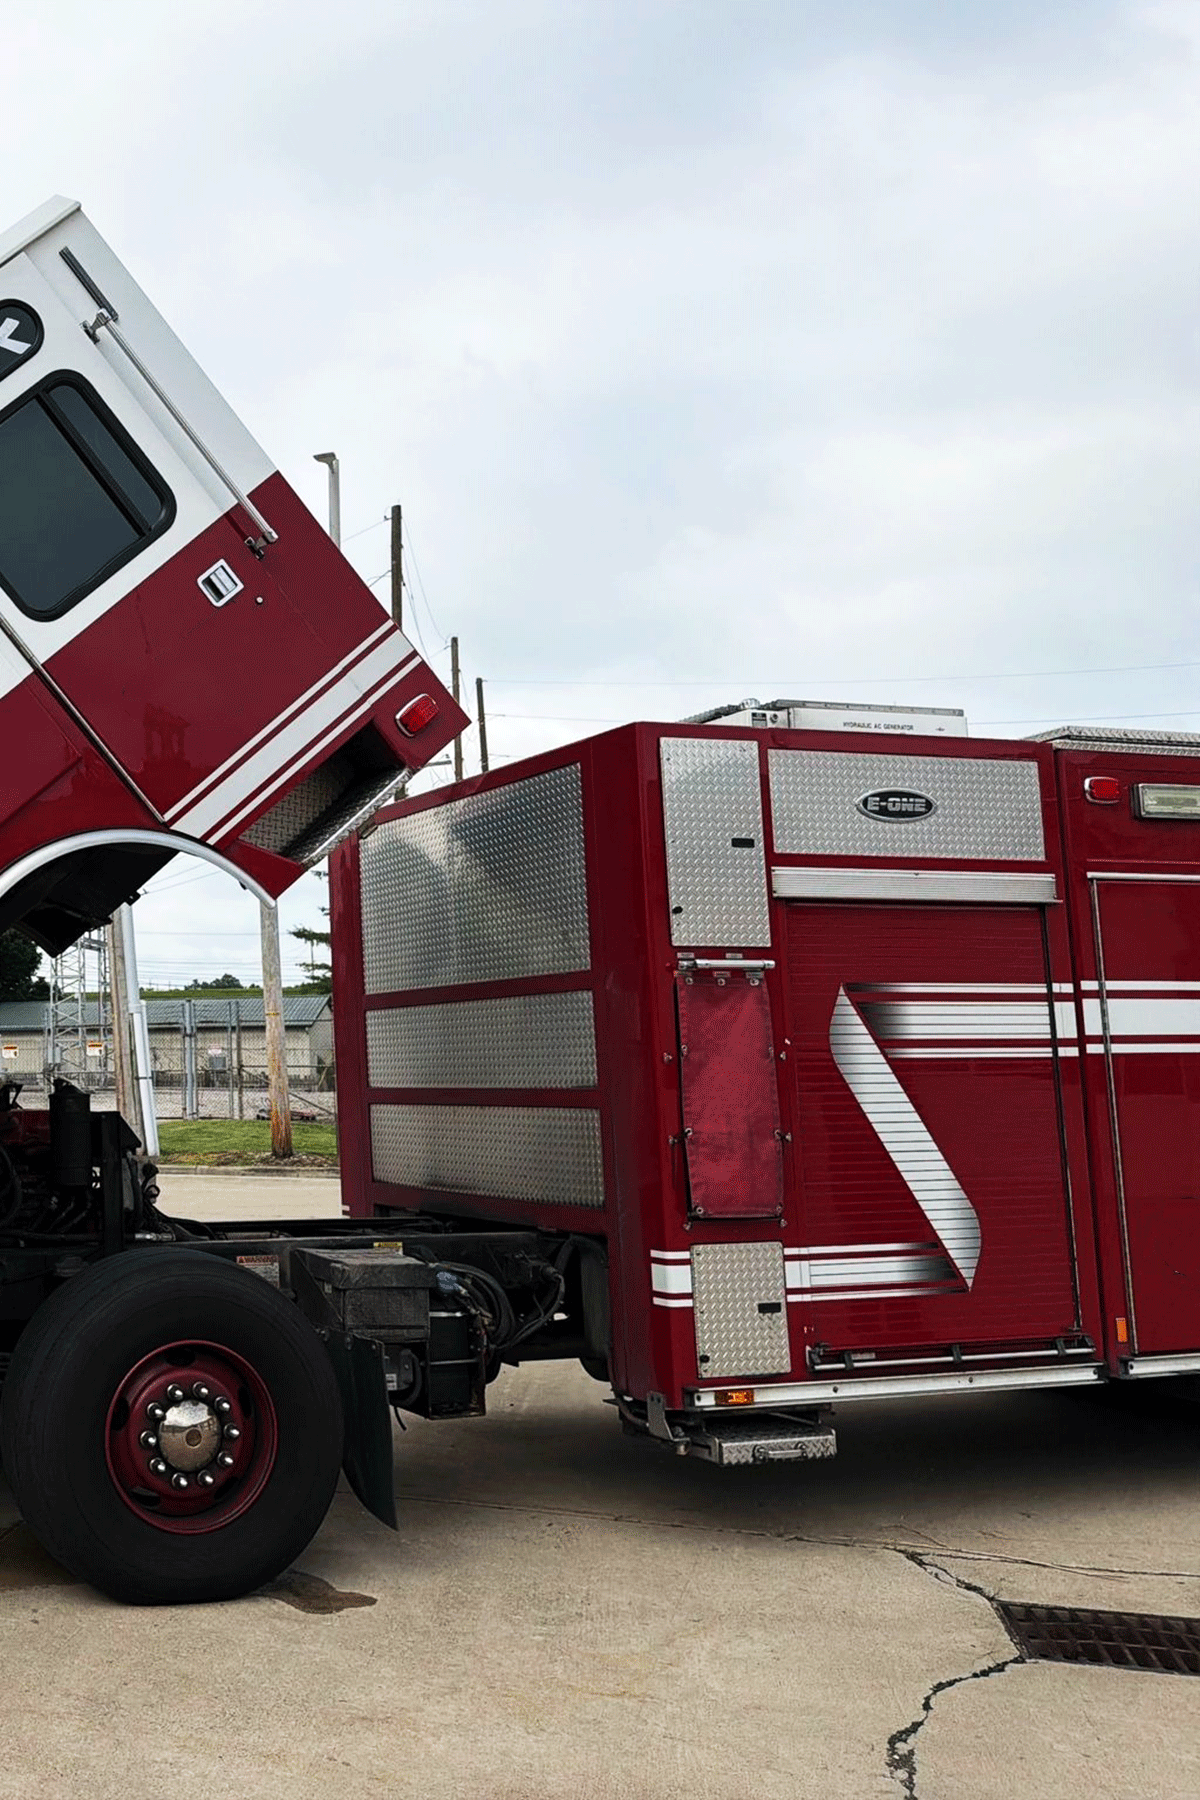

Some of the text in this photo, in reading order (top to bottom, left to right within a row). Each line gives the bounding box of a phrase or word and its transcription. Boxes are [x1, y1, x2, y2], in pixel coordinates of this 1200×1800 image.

[843, 721, 872, 729] HYDRAULIC
[883, 723, 914, 731] GENERATOR
[867, 796, 927, 812] E-ONE
